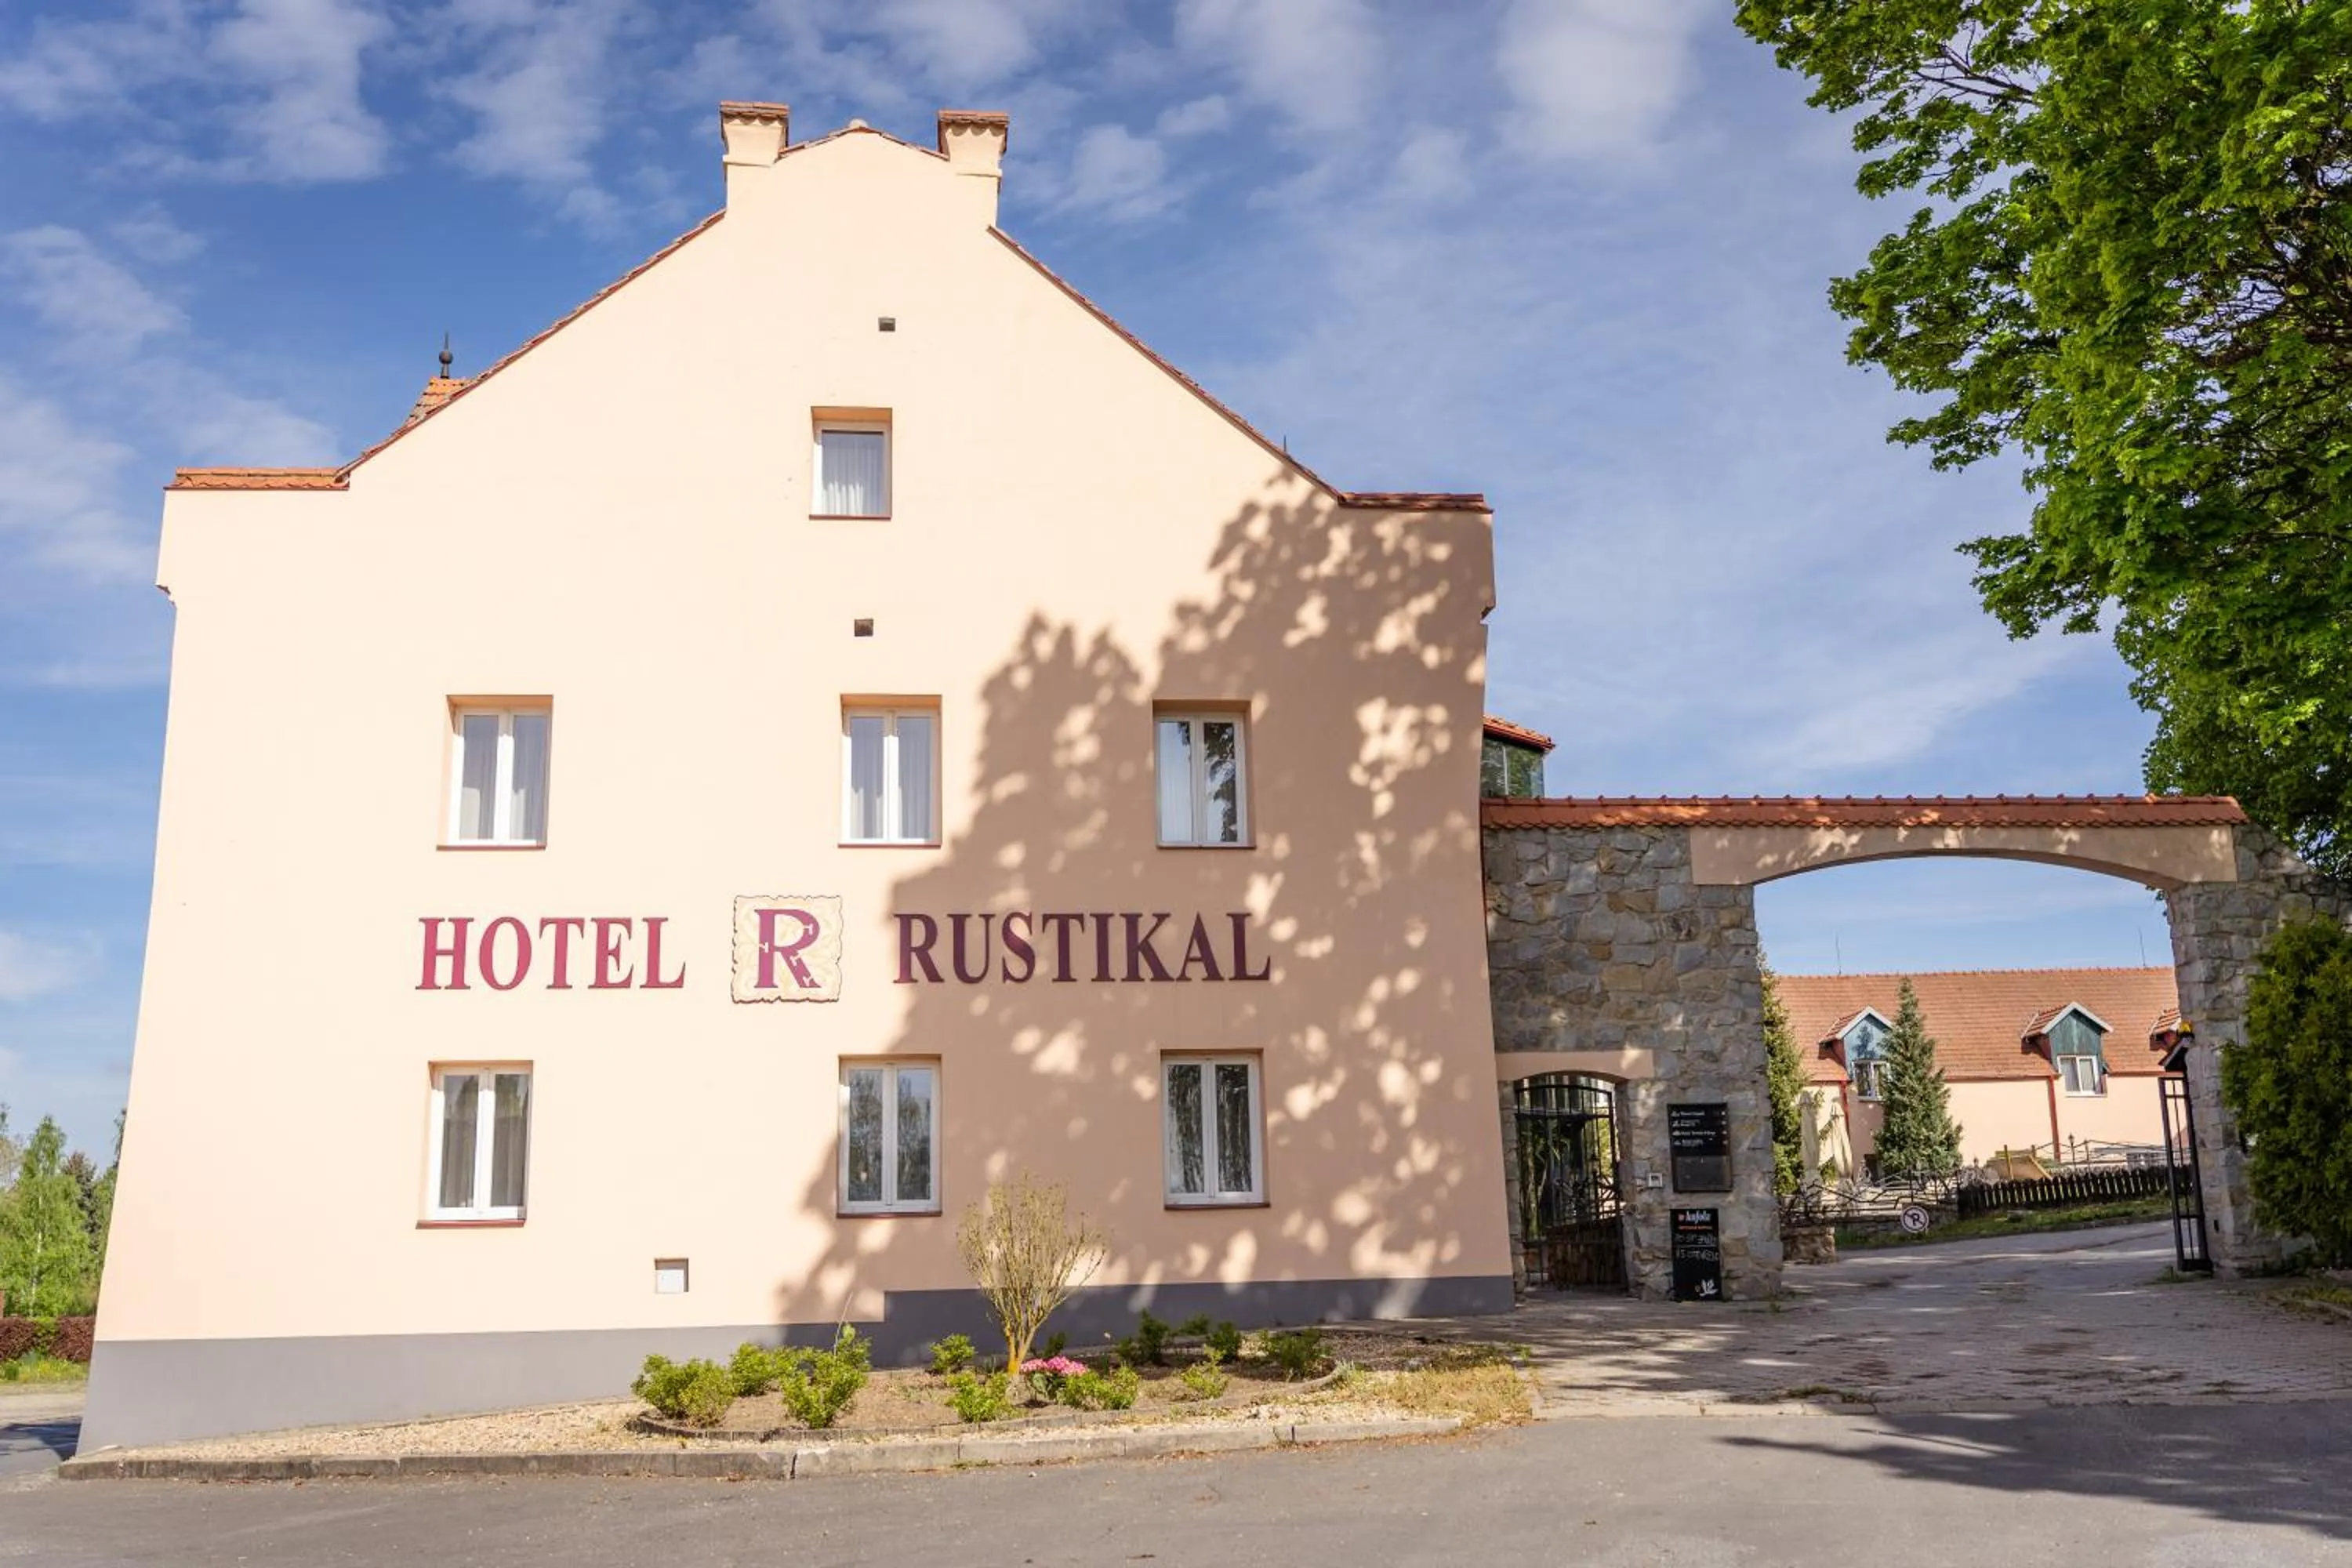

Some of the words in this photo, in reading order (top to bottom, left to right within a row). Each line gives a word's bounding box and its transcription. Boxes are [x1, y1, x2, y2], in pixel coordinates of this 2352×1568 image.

[415, 916, 686, 991] HOTEL
[753, 909, 822, 989] R
[892, 912, 1272, 984] RUSTIKAL
